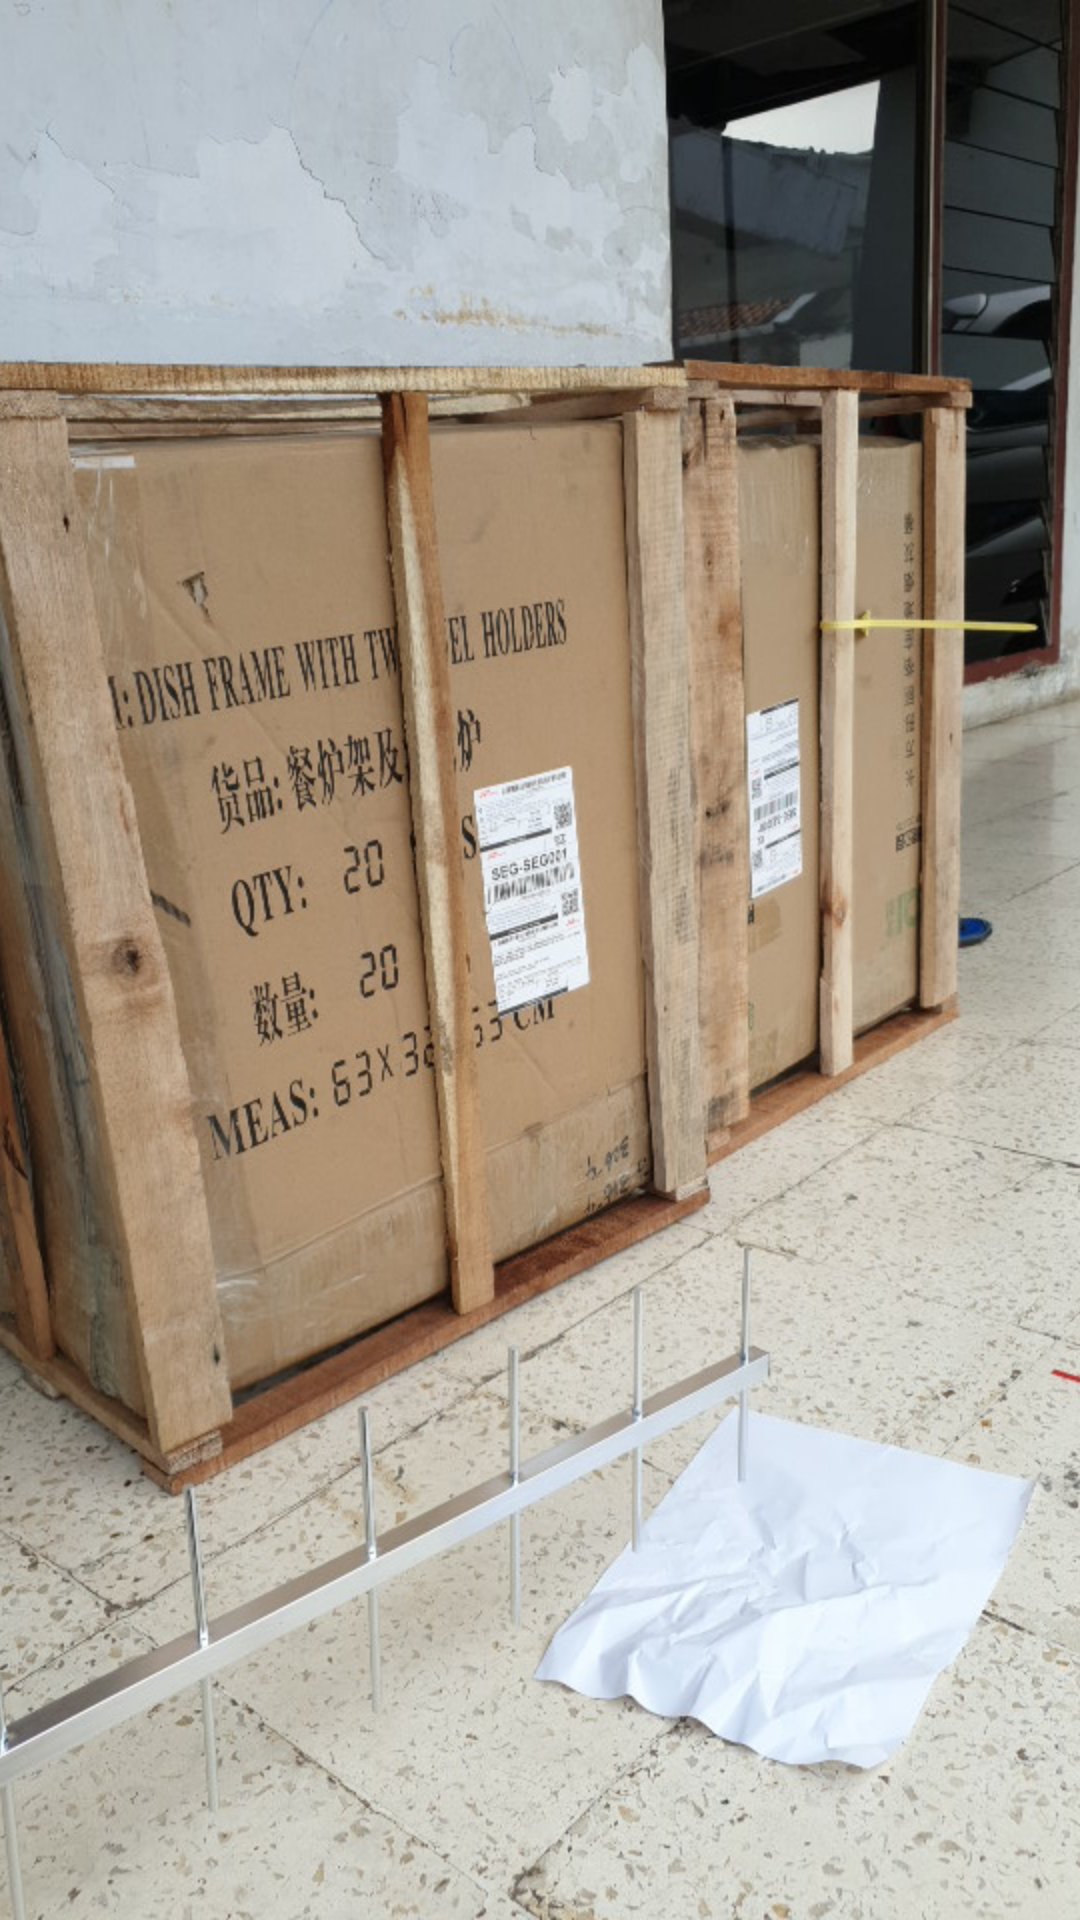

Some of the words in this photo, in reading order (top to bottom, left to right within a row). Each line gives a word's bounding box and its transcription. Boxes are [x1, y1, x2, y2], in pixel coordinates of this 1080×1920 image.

[133, 661, 200, 726] DISH
[202, 645, 291, 712] FRAME
[294, 634, 360, 692] WITH
[364, 622, 400, 682] TW
[444, 615, 475, 665] EL
[481, 598, 568, 659] HOLDERS
[231, 865, 308, 938] QTY:
[343, 838, 385, 895] 20
[358, 943, 399, 998] 20
[206, 1079, 320, 1162] MEAS:
